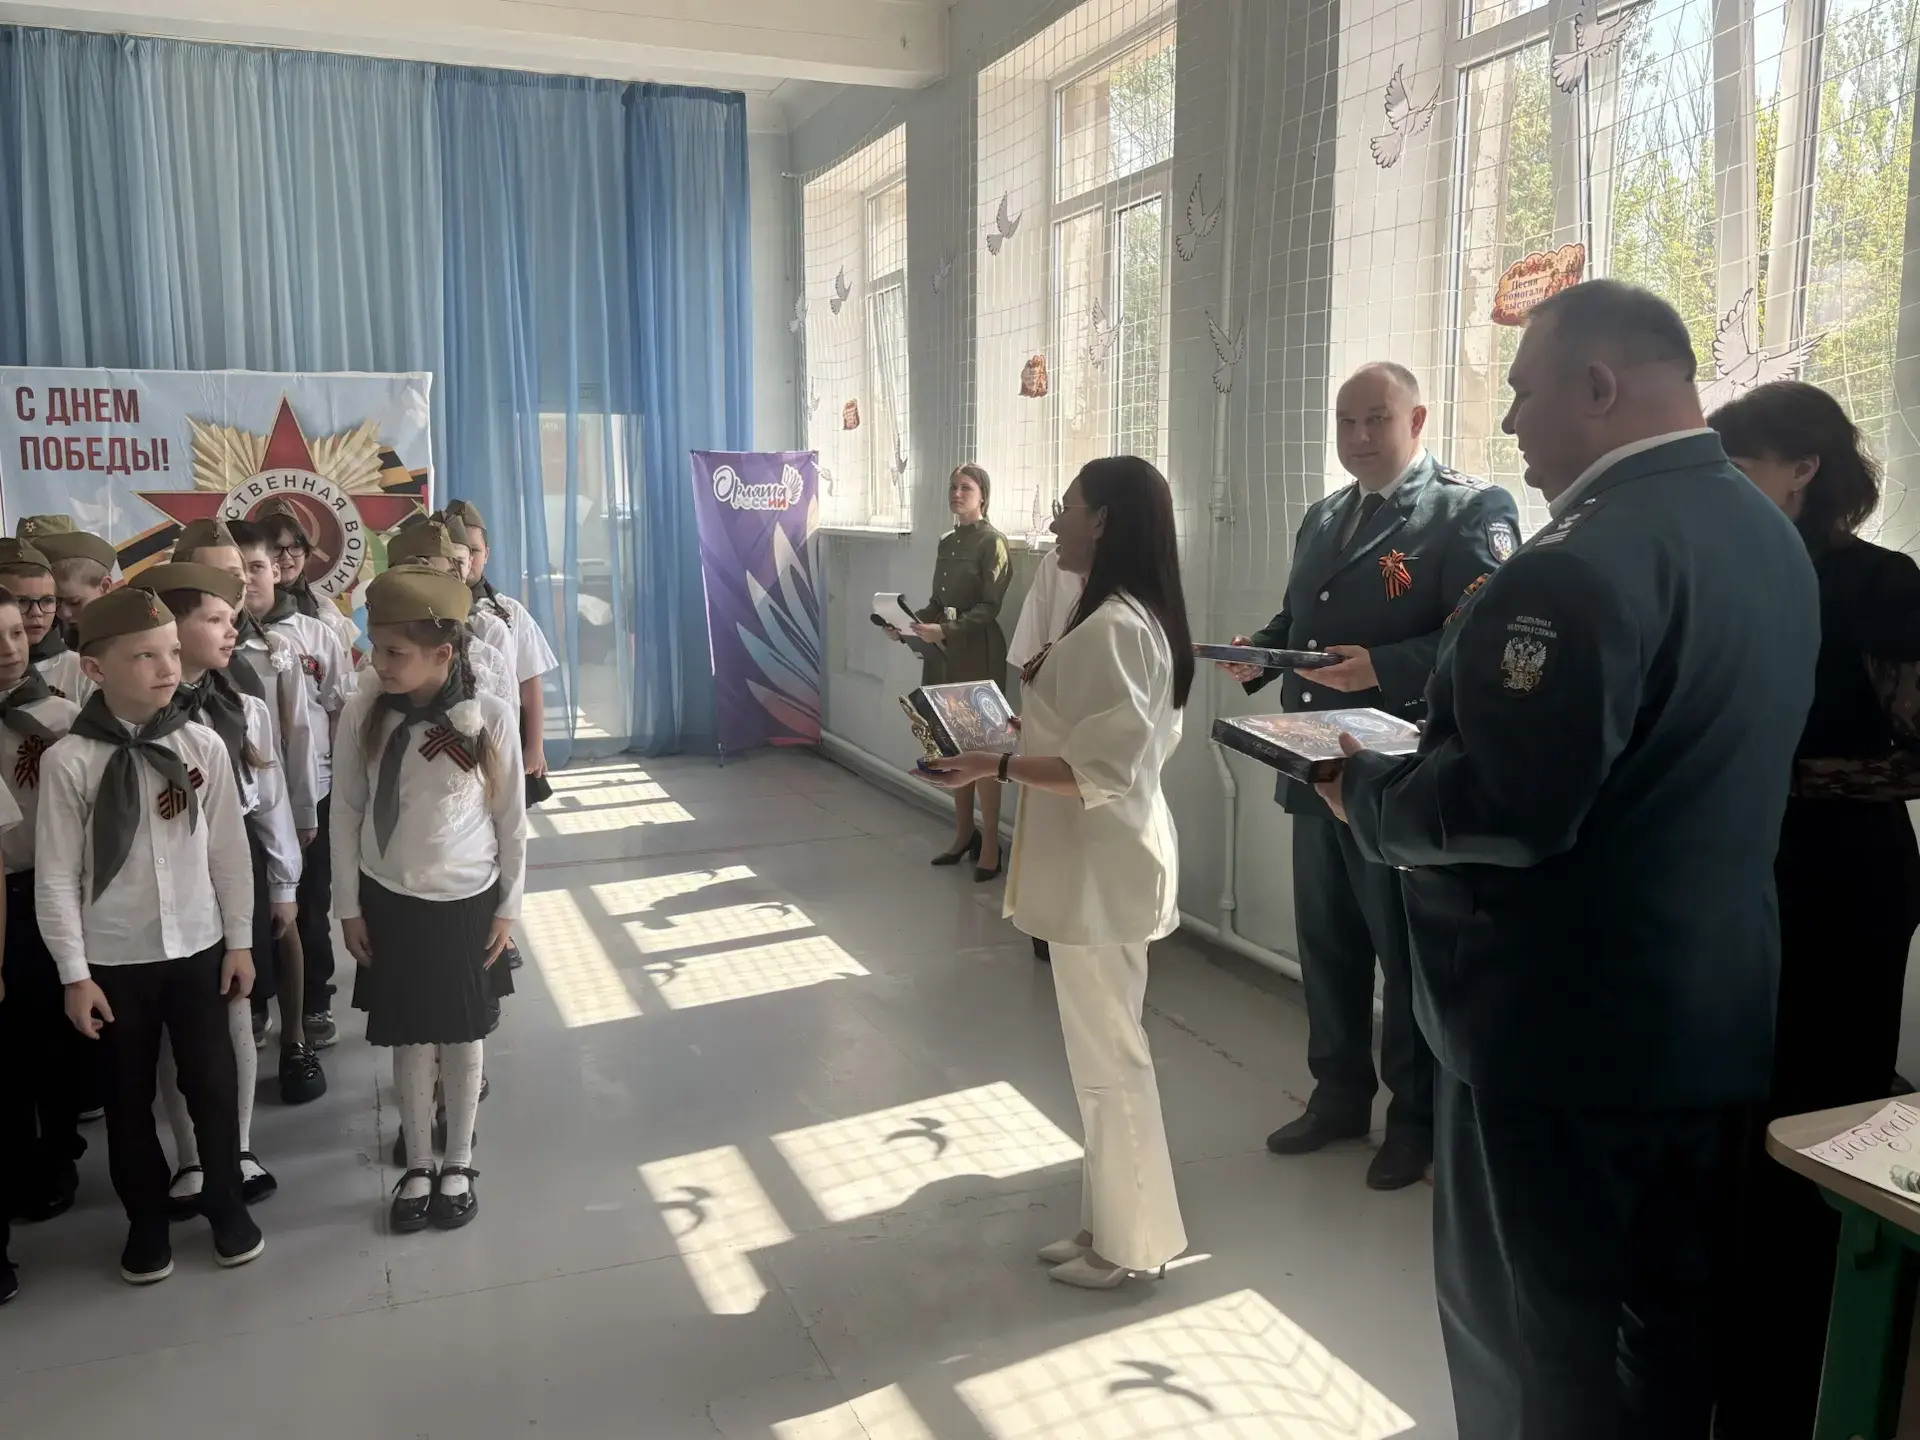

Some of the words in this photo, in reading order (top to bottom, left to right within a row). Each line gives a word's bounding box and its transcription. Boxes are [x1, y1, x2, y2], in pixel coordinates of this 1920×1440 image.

[1503, 287, 1544, 301] помогали
[1504, 297, 1544, 310] выстоят
[15, 386, 35, 422] С
[46, 387, 140, 426] ДНЕМ
[19, 436, 169, 475] ПОБЕДЫ!
[714, 466, 787, 505] Орлята
[225, 474, 347, 520] СТВЕННАЯ
[320, 520, 362, 594] ВОЙНА
